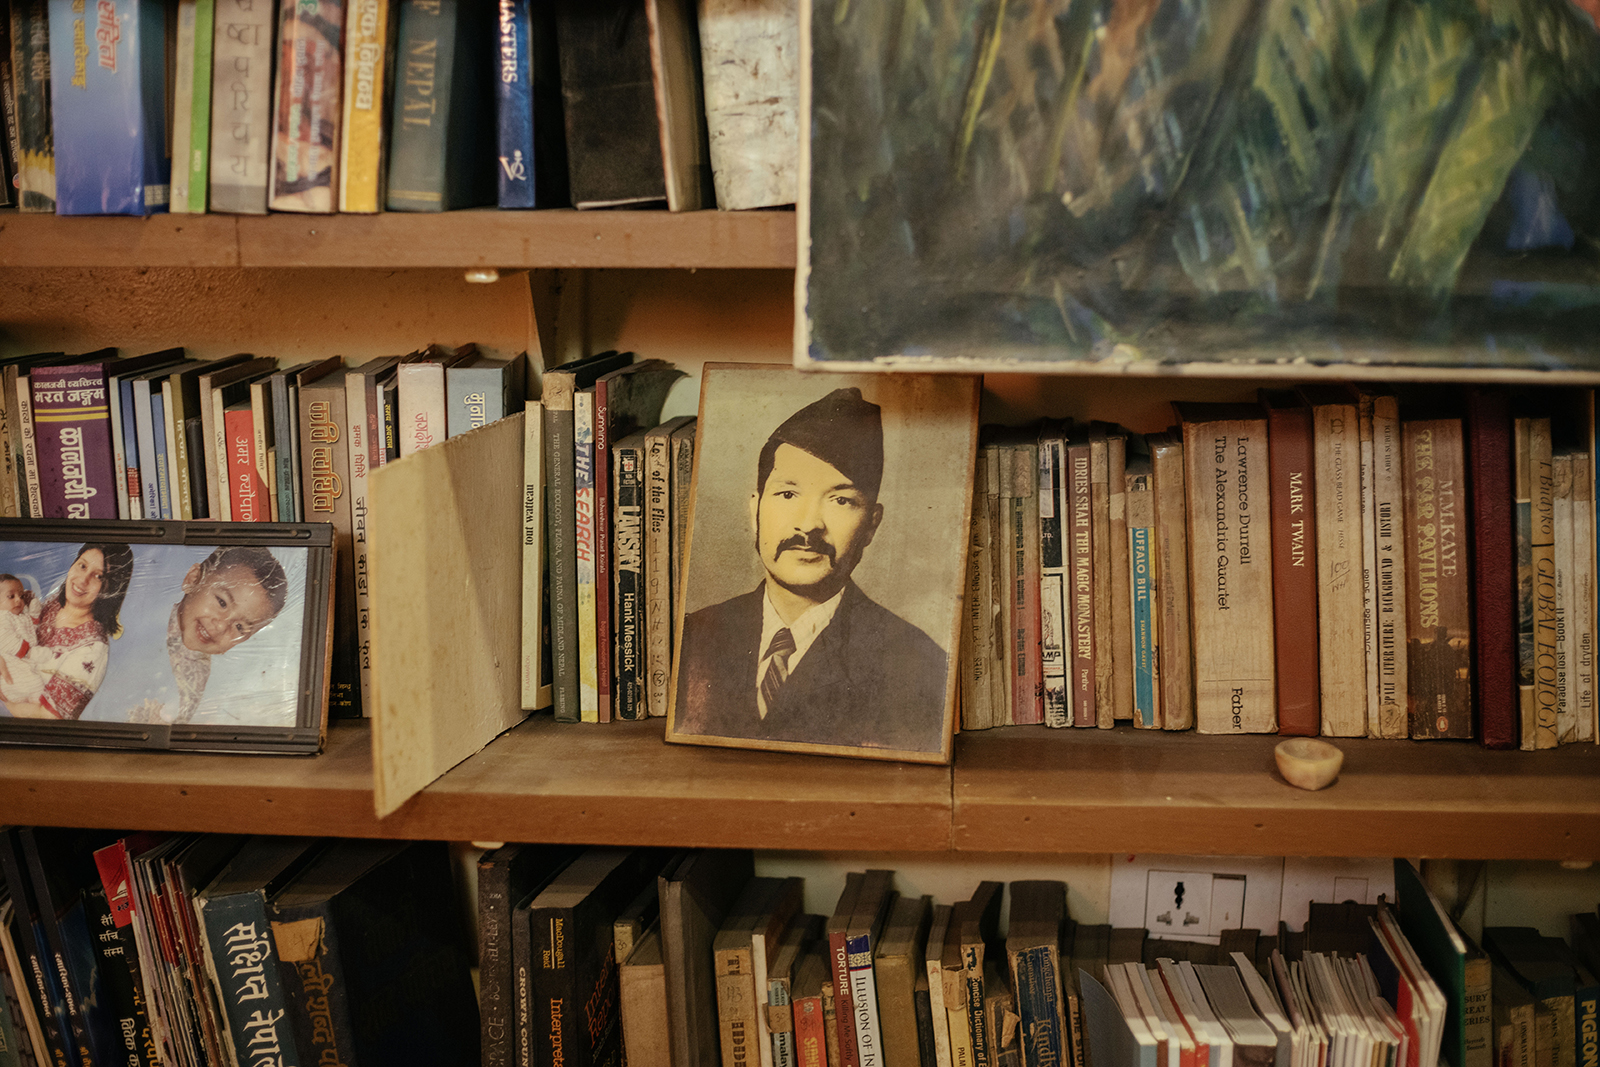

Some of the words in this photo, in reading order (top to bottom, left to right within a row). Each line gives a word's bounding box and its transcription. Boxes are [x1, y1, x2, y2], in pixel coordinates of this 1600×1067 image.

[35, 391, 64, 403] भरत
[309, 401, 340, 444] कवि
[597, 405, 608, 450] Sumnimo
[60, 427, 97, 499] कालजयी
[236, 435, 250, 466] अमर
[576, 443, 591, 481] THE
[1215, 436, 1228, 464] The
[1416, 430, 1432, 472] THE
[553, 451, 561, 487] GENERAL
[652, 470, 666, 483] of
[1075, 457, 1089, 493] IDRIES
[1237, 437, 1250, 511] Lawrence
[1335, 458, 1343, 480] GLASS
[524, 485, 534, 522] watteau
[652, 486, 666, 504] the
[1076, 495, 1089, 527] SHAH
[1216, 467, 1229, 553] Alexandria
[1290, 471, 1304, 515] MARK
[1417, 477, 1435, 519] FAR
[1536, 475, 1553, 535] Budyko
[355, 497, 369, 544] जीवन
[524, 527, 534, 546] tout
[575, 487, 591, 562] SEARCH
[618, 505, 641, 573] LANSKY
[651, 507, 666, 534] Flies
[1379, 502, 1392, 539] HISTORY
[1076, 531, 1090, 554] THE
[1239, 514, 1252, 566] Durrell
[1291, 519, 1305, 568] TWAIN
[1381, 544, 1393, 552] &
[1076, 556, 1090, 591] MAGIC
[1137, 577, 1147, 603] BILL
[1217, 555, 1229, 611] Quartet
[1381, 558, 1394, 613] BACKGROUND
[1418, 524, 1439, 628] PAVILIONS
[557, 603, 564, 614] OF
[624, 592, 636, 623] Hank
[1537, 558, 1556, 634] GLOBAL
[557, 616, 565, 651] MIDLAND
[1077, 594, 1091, 660] MONASTERY
[558, 653, 566, 677] NEPAL
[624, 624, 636, 672] Messick
[1556, 652, 1566, 670] lost
[1580, 633, 1592, 667] dryden
[1081, 669, 1090, 692] Panther
[1537, 641, 1557, 737] ECOLOGY
[1556, 672, 1567, 714] Paradise
[1580, 673, 1591, 684] of
[1231, 687, 1244, 730] Faber
[1580, 691, 1591, 709] Life
[554, 918, 566, 969] MacDougall
[836, 956, 850, 996] TORTURE
[972, 976, 982, 1008] Concise
[519, 966, 528, 1026] CROWN,
[855, 976, 868, 1031] ILLUSION
[120, 1018, 138, 1051] विवेक
[842, 1025, 852, 1038] Me
[861, 1034, 873, 1050] OF
[973, 1010, 985, 1051] Dictionary
[844, 1039, 855, 1062] Softly
[977, 1052, 986, 1061] of
